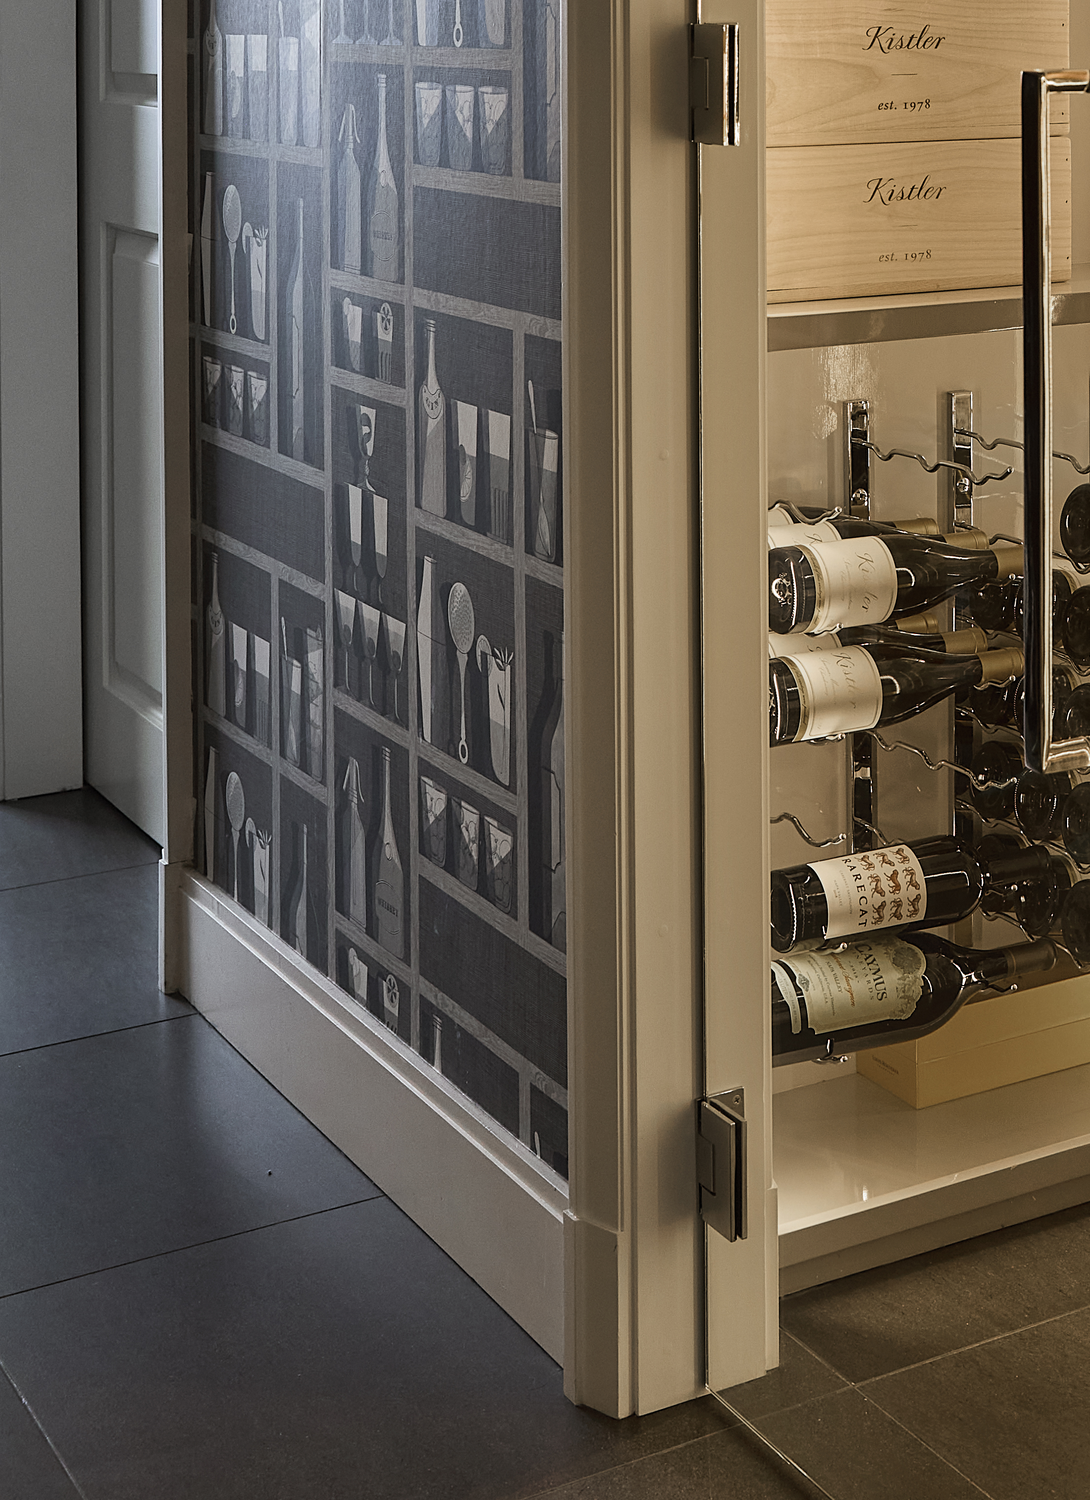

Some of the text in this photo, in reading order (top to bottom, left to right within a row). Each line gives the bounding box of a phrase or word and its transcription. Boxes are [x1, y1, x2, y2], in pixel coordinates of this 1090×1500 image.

[862, 24, 946, 54] Kistler
[877, 98, 931, 112] est. 1978
[862, 174, 946, 206] Kistler
[878, 249, 932, 262] est. 1978
[842, 858, 868, 927] RARECAT
[825, 961, 843, 994] NAPA VALLEY
[855, 943, 888, 1001] CAYMUS
